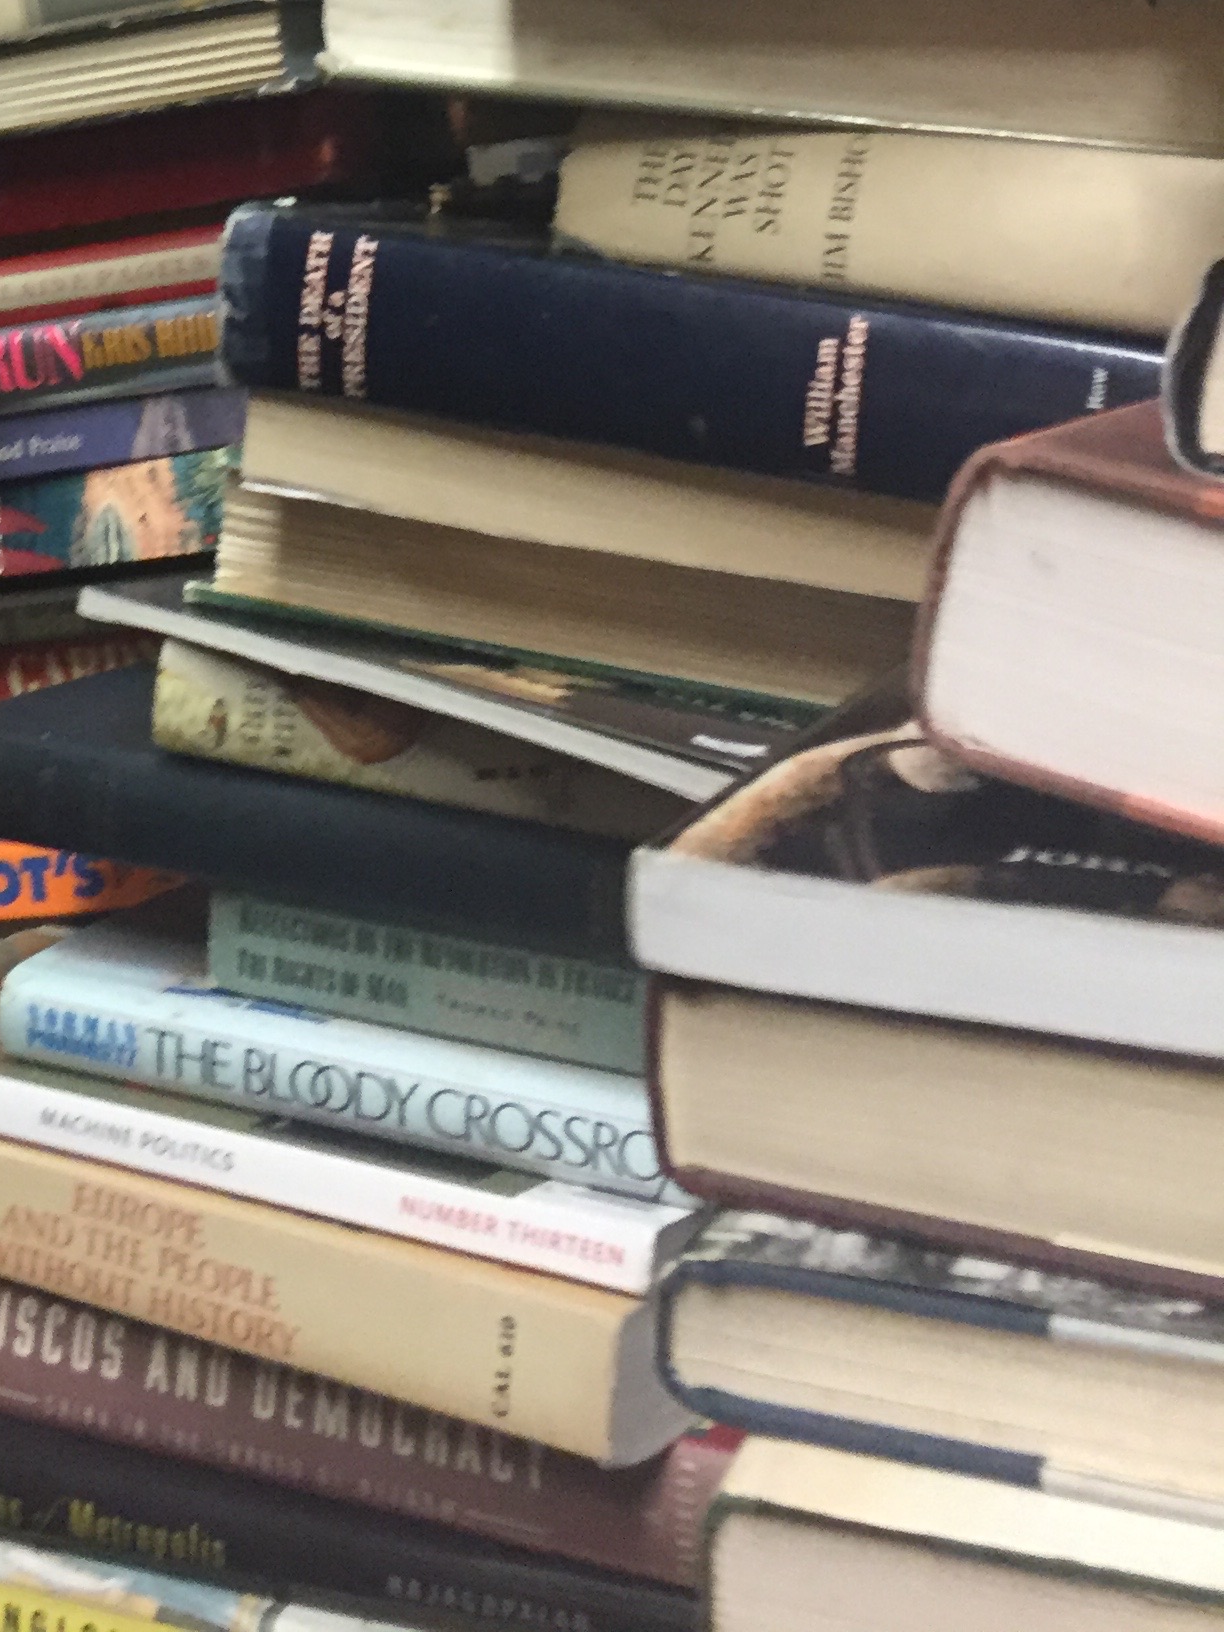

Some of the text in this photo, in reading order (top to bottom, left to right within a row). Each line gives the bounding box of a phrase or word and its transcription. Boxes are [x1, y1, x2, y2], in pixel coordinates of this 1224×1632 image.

[633, 148, 670, 206] THE
[662, 150, 699, 208] DAY
[722, 152, 759, 220] WAS
[752, 148, 796, 237] SHOT
[296, 229, 335, 390] THE DEATH
[341, 234, 380, 398] PRESIDENT
[802, 337, 840, 448] William
[829, 313, 871, 475] Manchester
[145, 1025, 666, 1184] THE BLOODY CROSSRO
[38, 1106, 132, 1148] MACHINE
[136, 1129, 237, 1173] POLITICS
[397, 1193, 501, 1236] NUMBER
[506, 1218, 628, 1268] THIRTEEN
[70, 1179, 208, 1251] EUROPE
[0, 1202, 281, 1314] AND THE PEOPLE
[142, 1332, 233, 1409] AND
[146, 1284, 303, 1359] HISTORY
